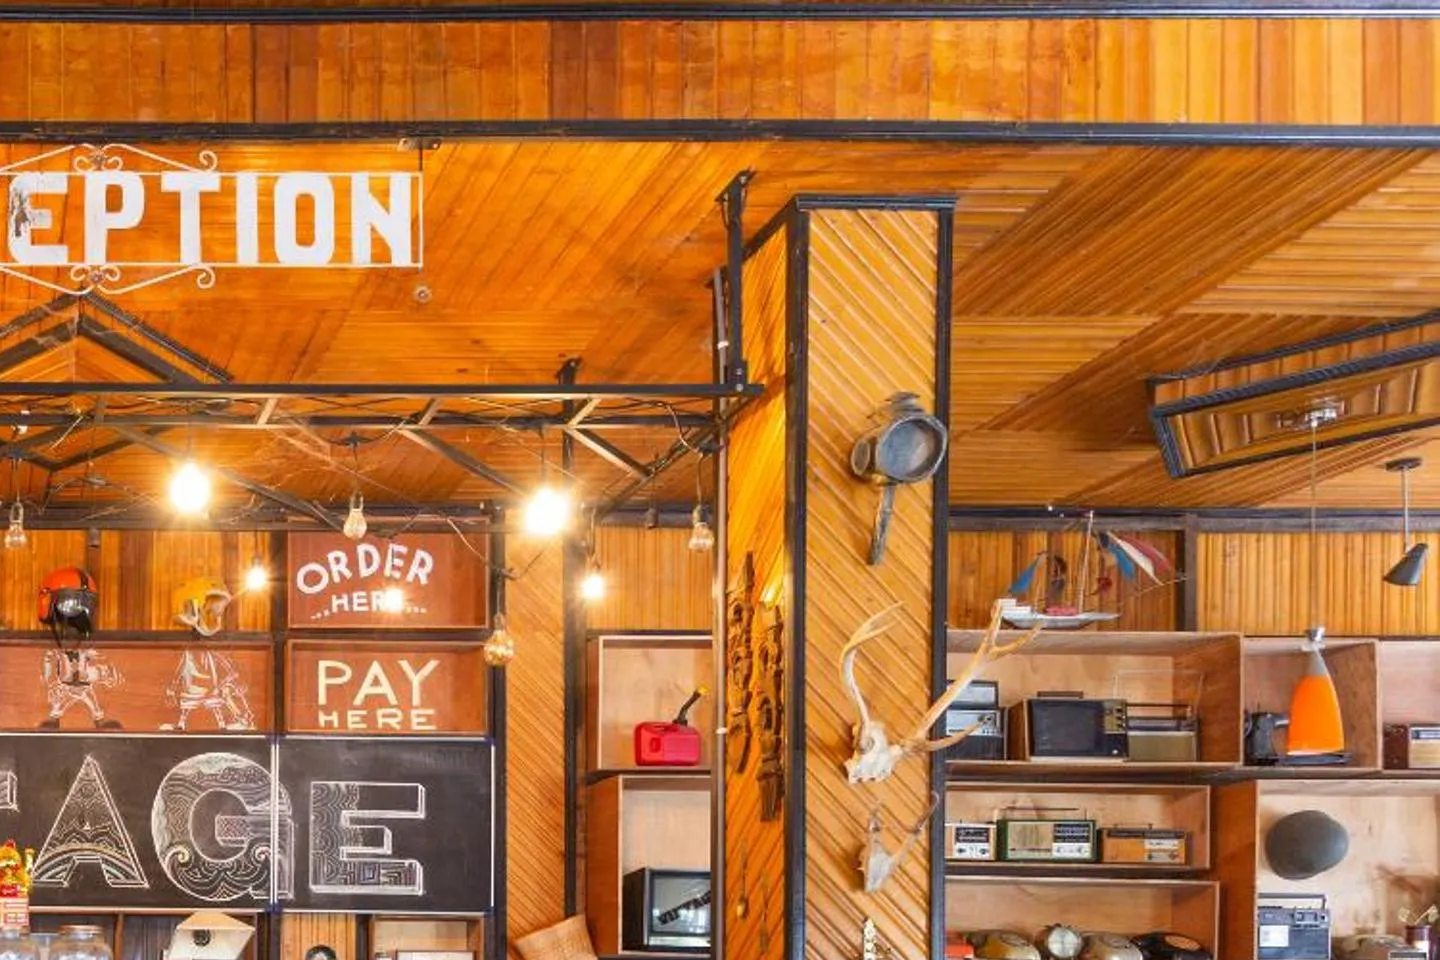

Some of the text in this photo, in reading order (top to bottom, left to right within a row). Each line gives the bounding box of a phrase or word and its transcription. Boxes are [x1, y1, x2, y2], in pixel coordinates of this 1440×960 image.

[296, 543, 434, 594] ORDER
[317, 659, 440, 707] PAY
[317, 708, 437, 731] HERE
